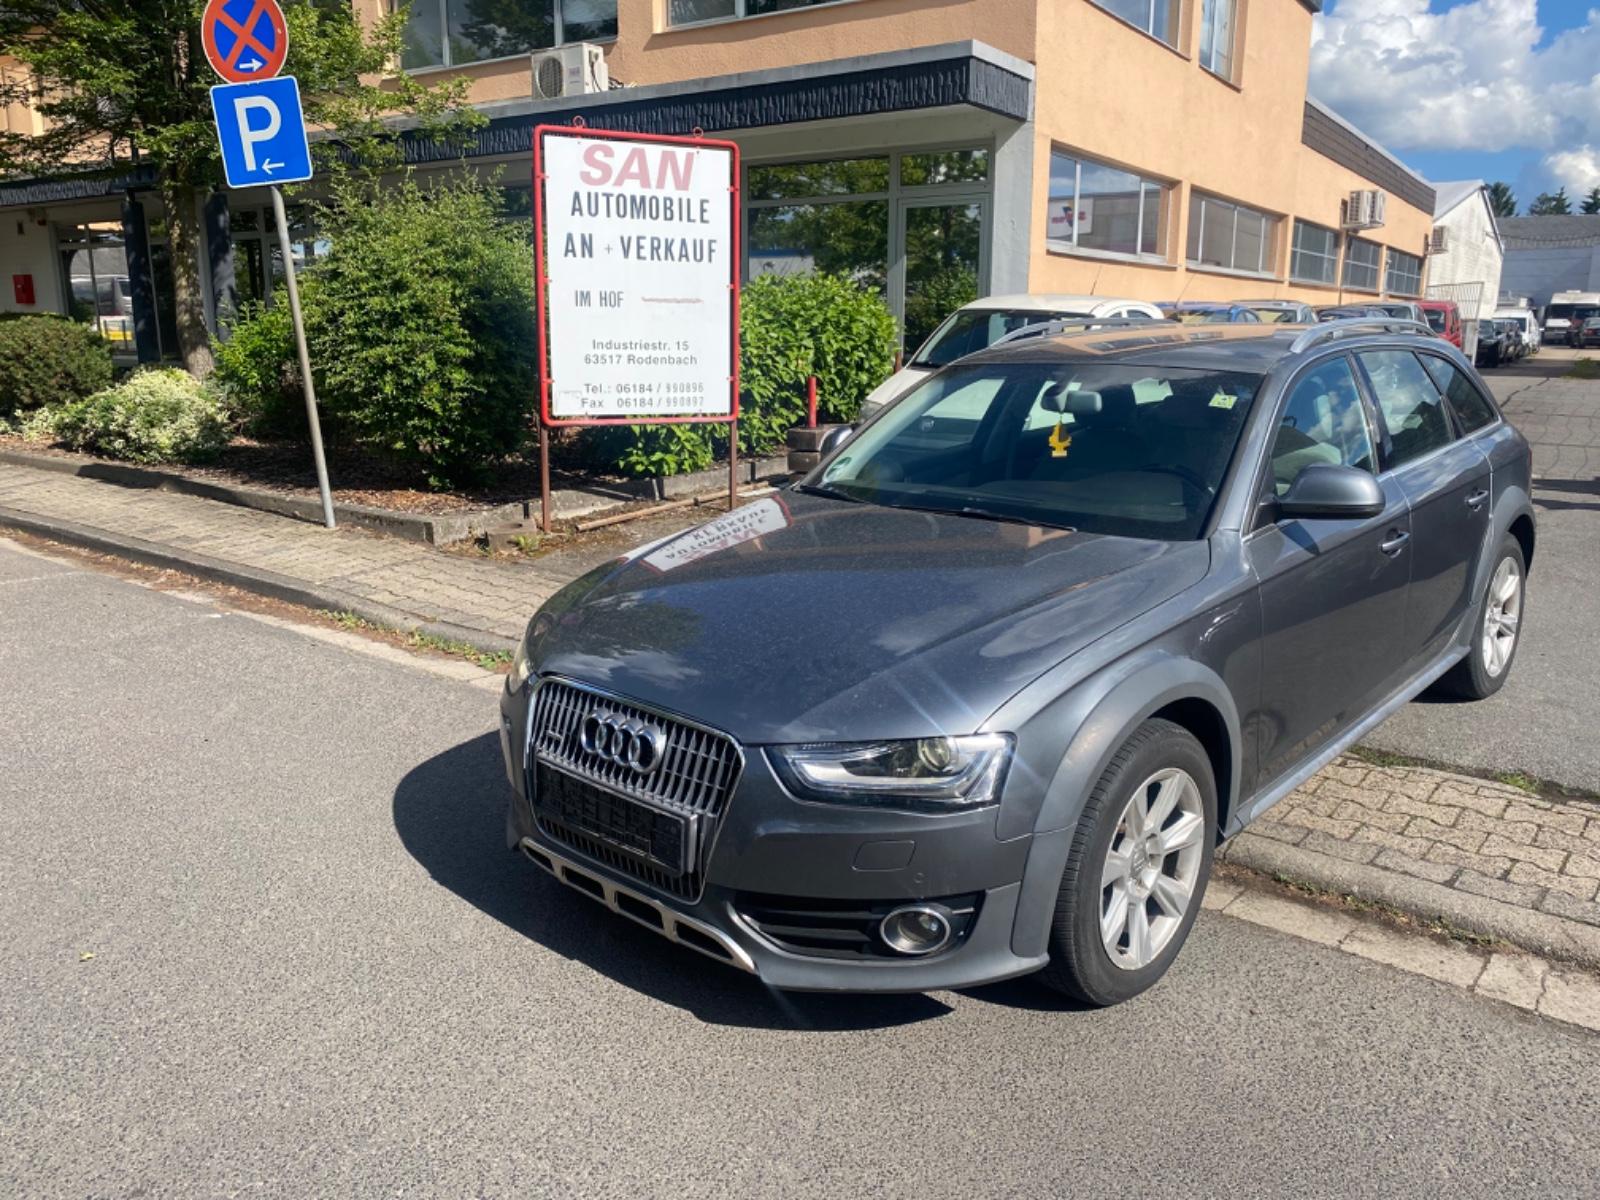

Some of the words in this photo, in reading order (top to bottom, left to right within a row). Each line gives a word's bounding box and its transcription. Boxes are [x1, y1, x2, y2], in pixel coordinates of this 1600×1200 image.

[233, 95, 282, 172] P
[579, 144, 695, 191] SAN
[571, 191, 710, 224] AUTOMOBILE
[564, 232, 594, 259] AN
[620, 236, 717, 263] VERKAUF
[574, 290, 592, 307] IM
[599, 291, 624, 308] HOF
[592, 339, 671, 351] Industriestr.
[676, 341, 690, 351] 15
[584, 354, 622, 365] 63517
[627, 354, 698, 365] Rodenbach
[616, 383, 653, 394] 06184
[581, 398, 604, 408] Fax
[617, 398, 653, 409] 06184
